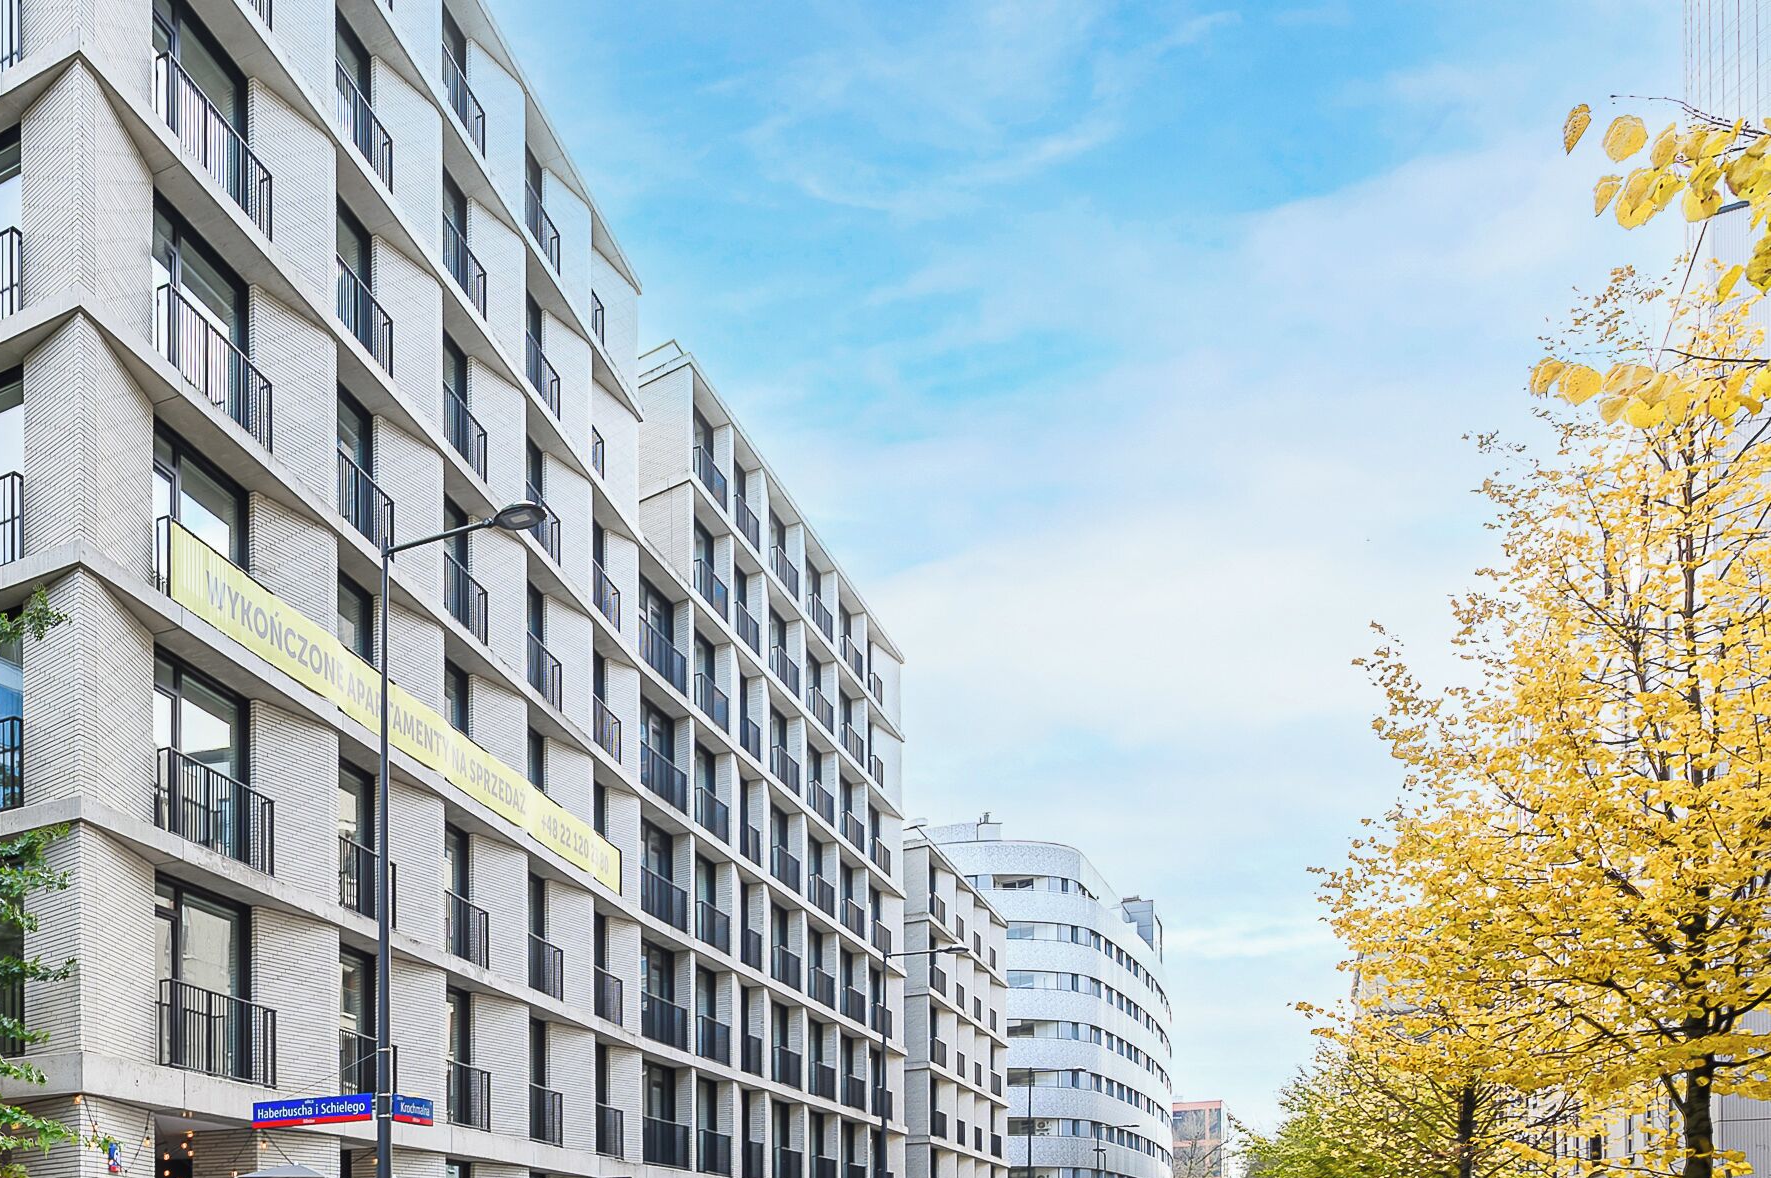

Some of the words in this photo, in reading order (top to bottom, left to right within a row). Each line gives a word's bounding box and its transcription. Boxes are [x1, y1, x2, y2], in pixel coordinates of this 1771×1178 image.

[206, 570, 344, 690] WYKOŃCZONE
[452, 745, 467, 778] NA
[470, 759, 526, 815] SPRZEDAŻ
[541, 815, 558, 840] +48
[560, 823, 571, 848] 22
[574, 832, 588, 859] 120
[257, 1104, 313, 1119] Haberbuscha
[315, 1104, 319, 1114] i
[321, 1102, 366, 1115] Schielego
[400, 1102, 430, 1116] Krochmalna
